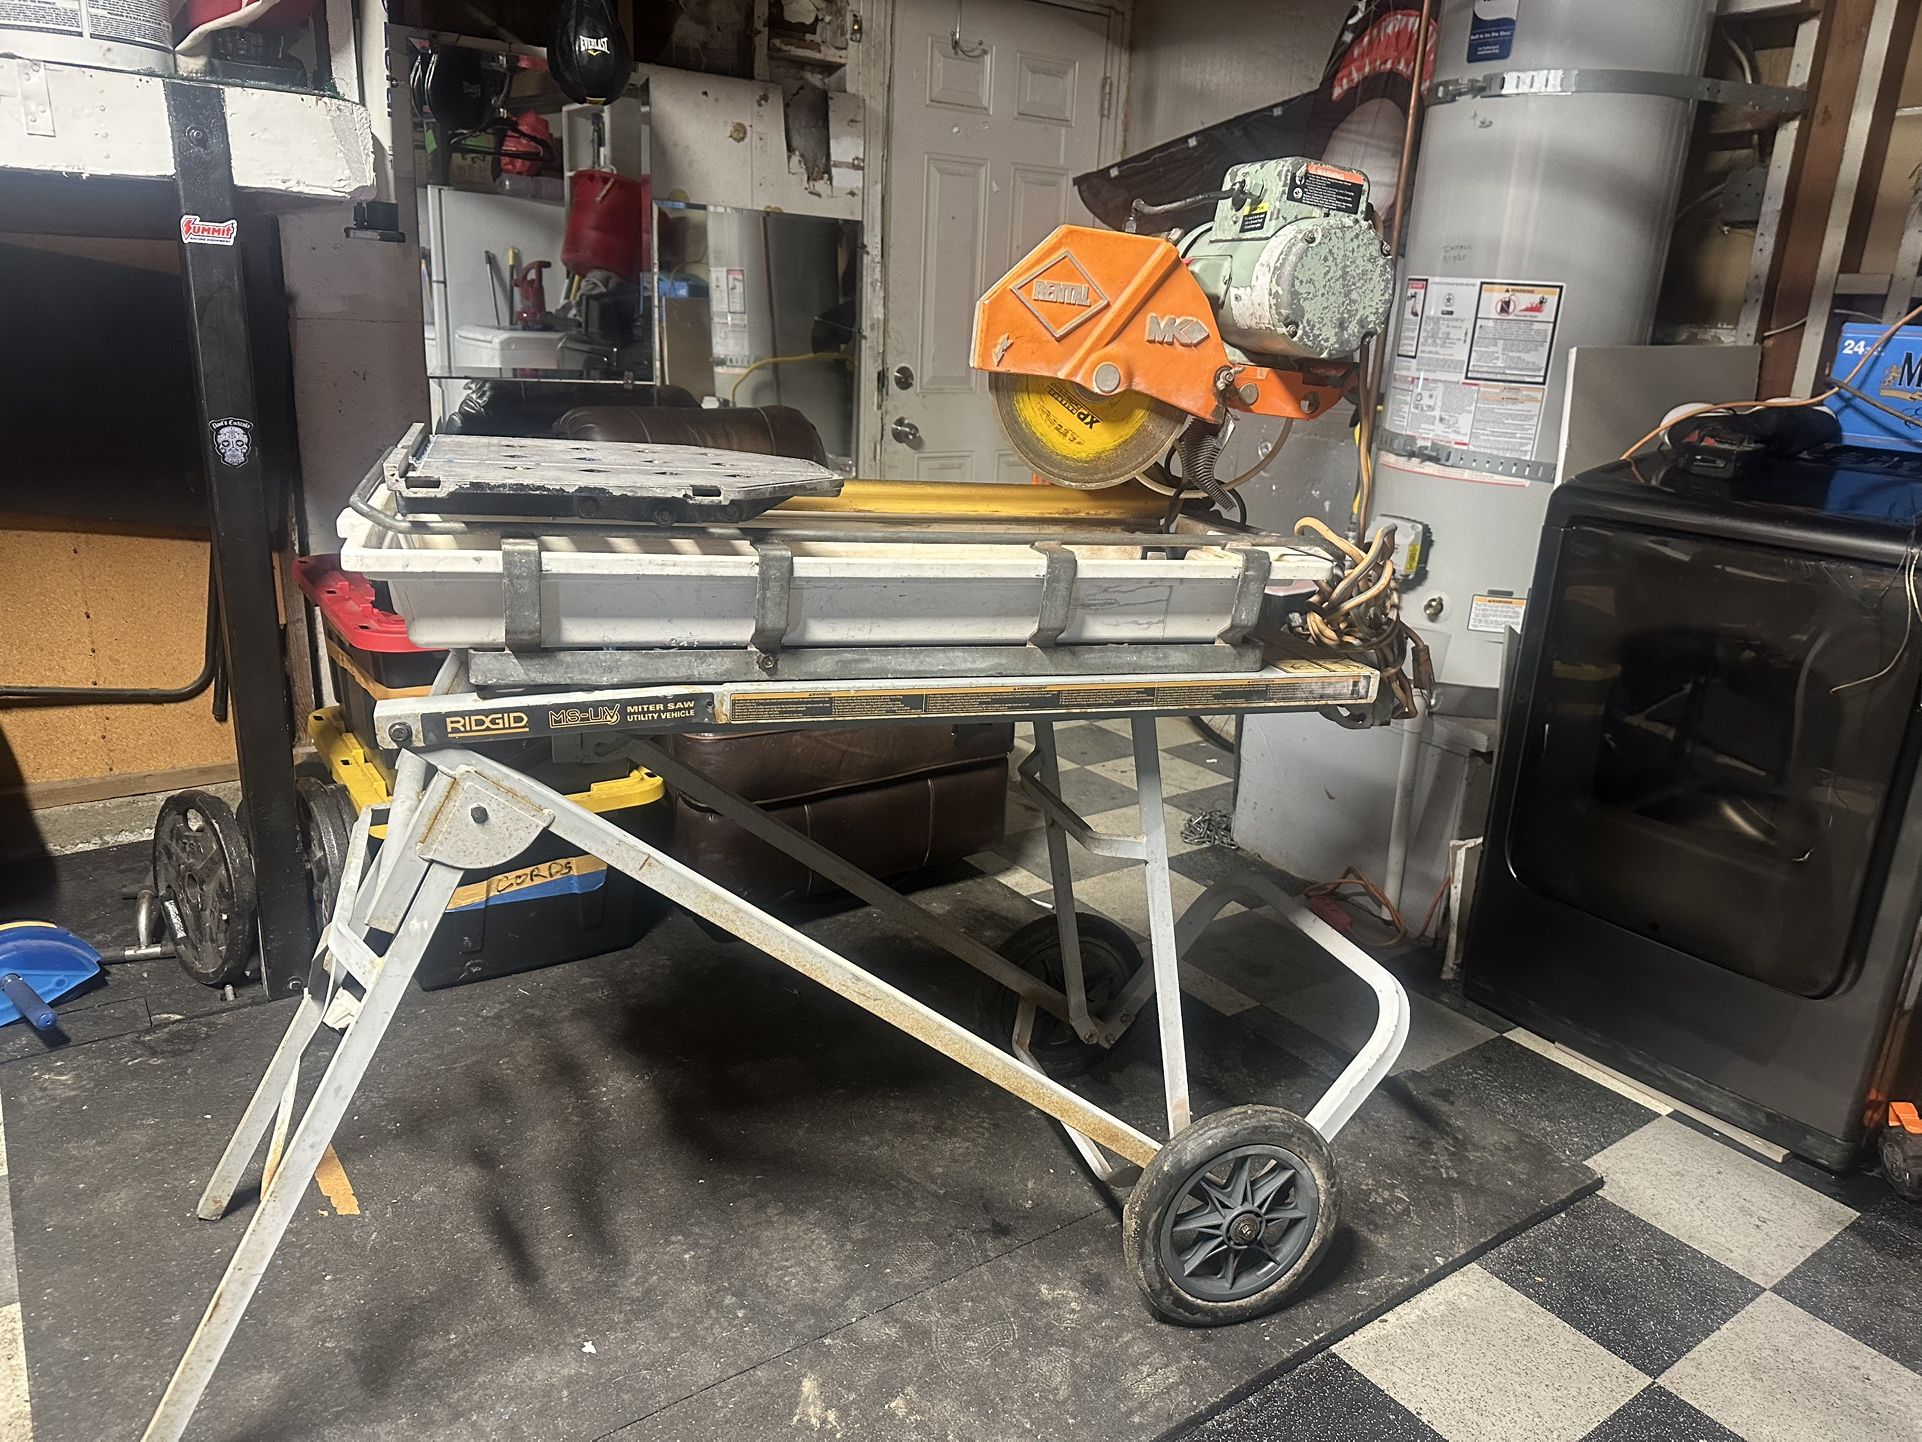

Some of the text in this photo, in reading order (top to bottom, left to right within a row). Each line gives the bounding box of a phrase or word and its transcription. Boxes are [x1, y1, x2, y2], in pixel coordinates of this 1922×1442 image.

[579, 35, 609, 53] EVERLAST
[1033, 280, 1091, 307] RENTAL
[1146, 312, 1189, 346] MK
[1842, 339, 1866, 355] 24
[1076, 410, 1103, 430] XP
[627, 701, 695, 713] MITER SAW
[627, 709, 695, 722] UTILITY VEHICLE
[446, 712, 528, 732] RIDGID
